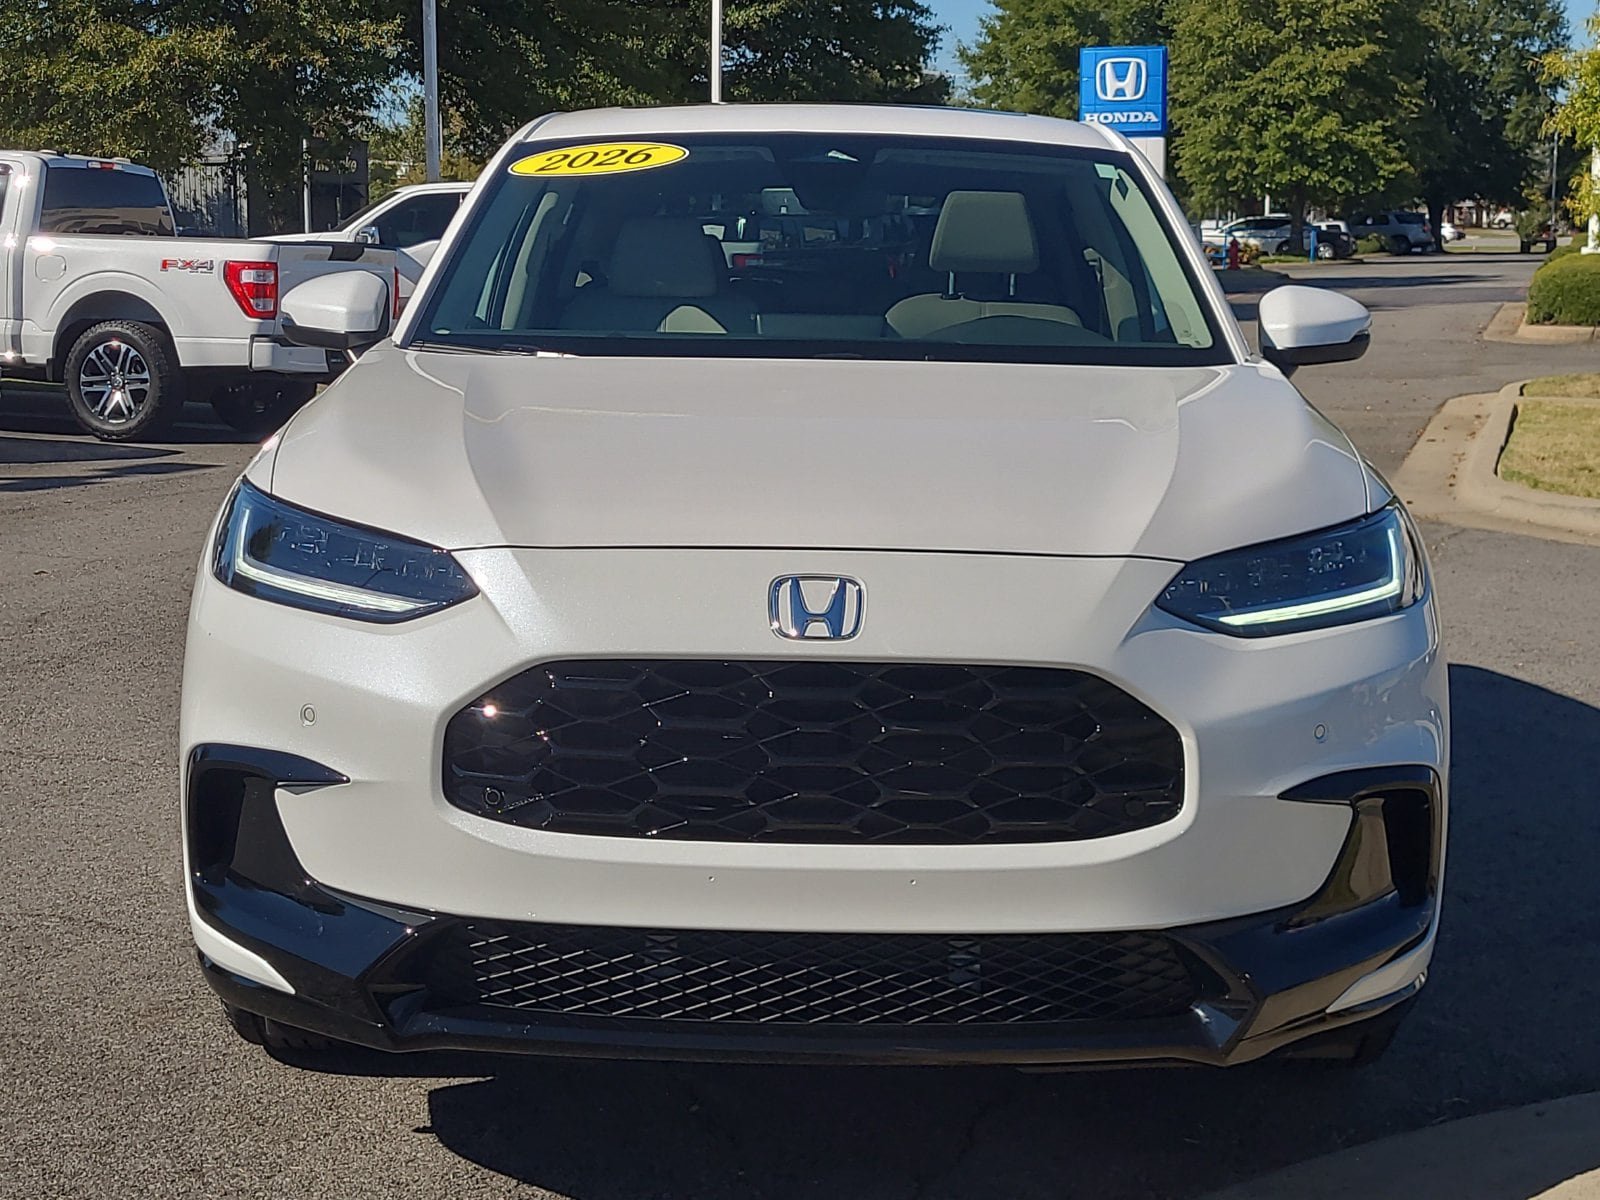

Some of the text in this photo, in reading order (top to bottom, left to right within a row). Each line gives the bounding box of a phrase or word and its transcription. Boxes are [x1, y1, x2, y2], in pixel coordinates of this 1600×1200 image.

[1084, 111, 1159, 124] HONDA
[534, 146, 661, 172] 2026
[160, 258, 214, 271] FX4
